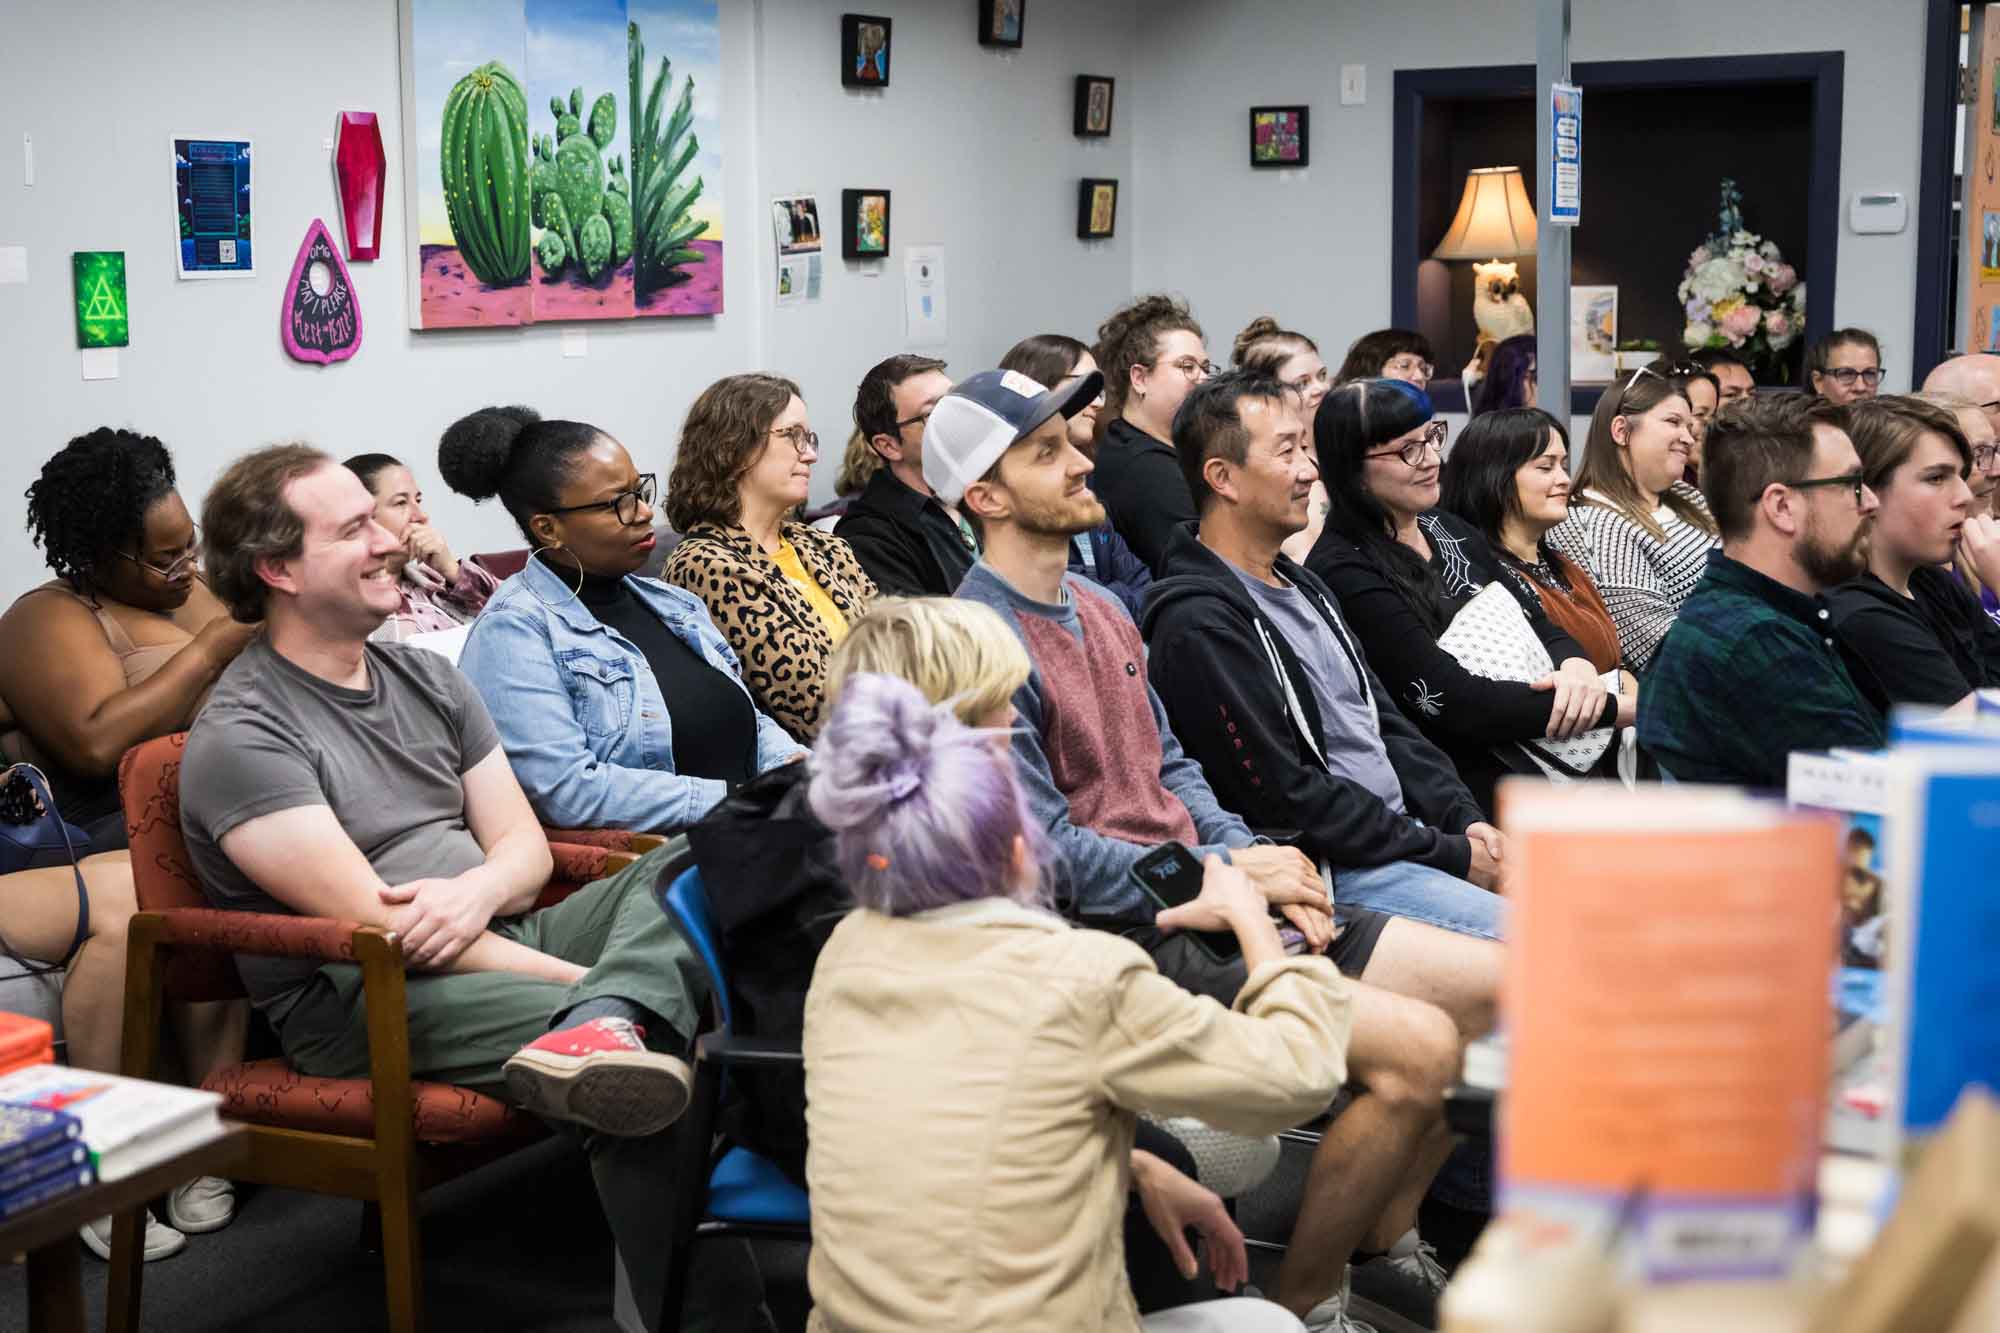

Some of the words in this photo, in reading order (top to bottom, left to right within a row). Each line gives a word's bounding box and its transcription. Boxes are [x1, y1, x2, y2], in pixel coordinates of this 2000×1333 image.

[310, 244, 331, 259] OMG
[312, 297, 320, 315] I
[321, 280, 347, 316] PLEASE
